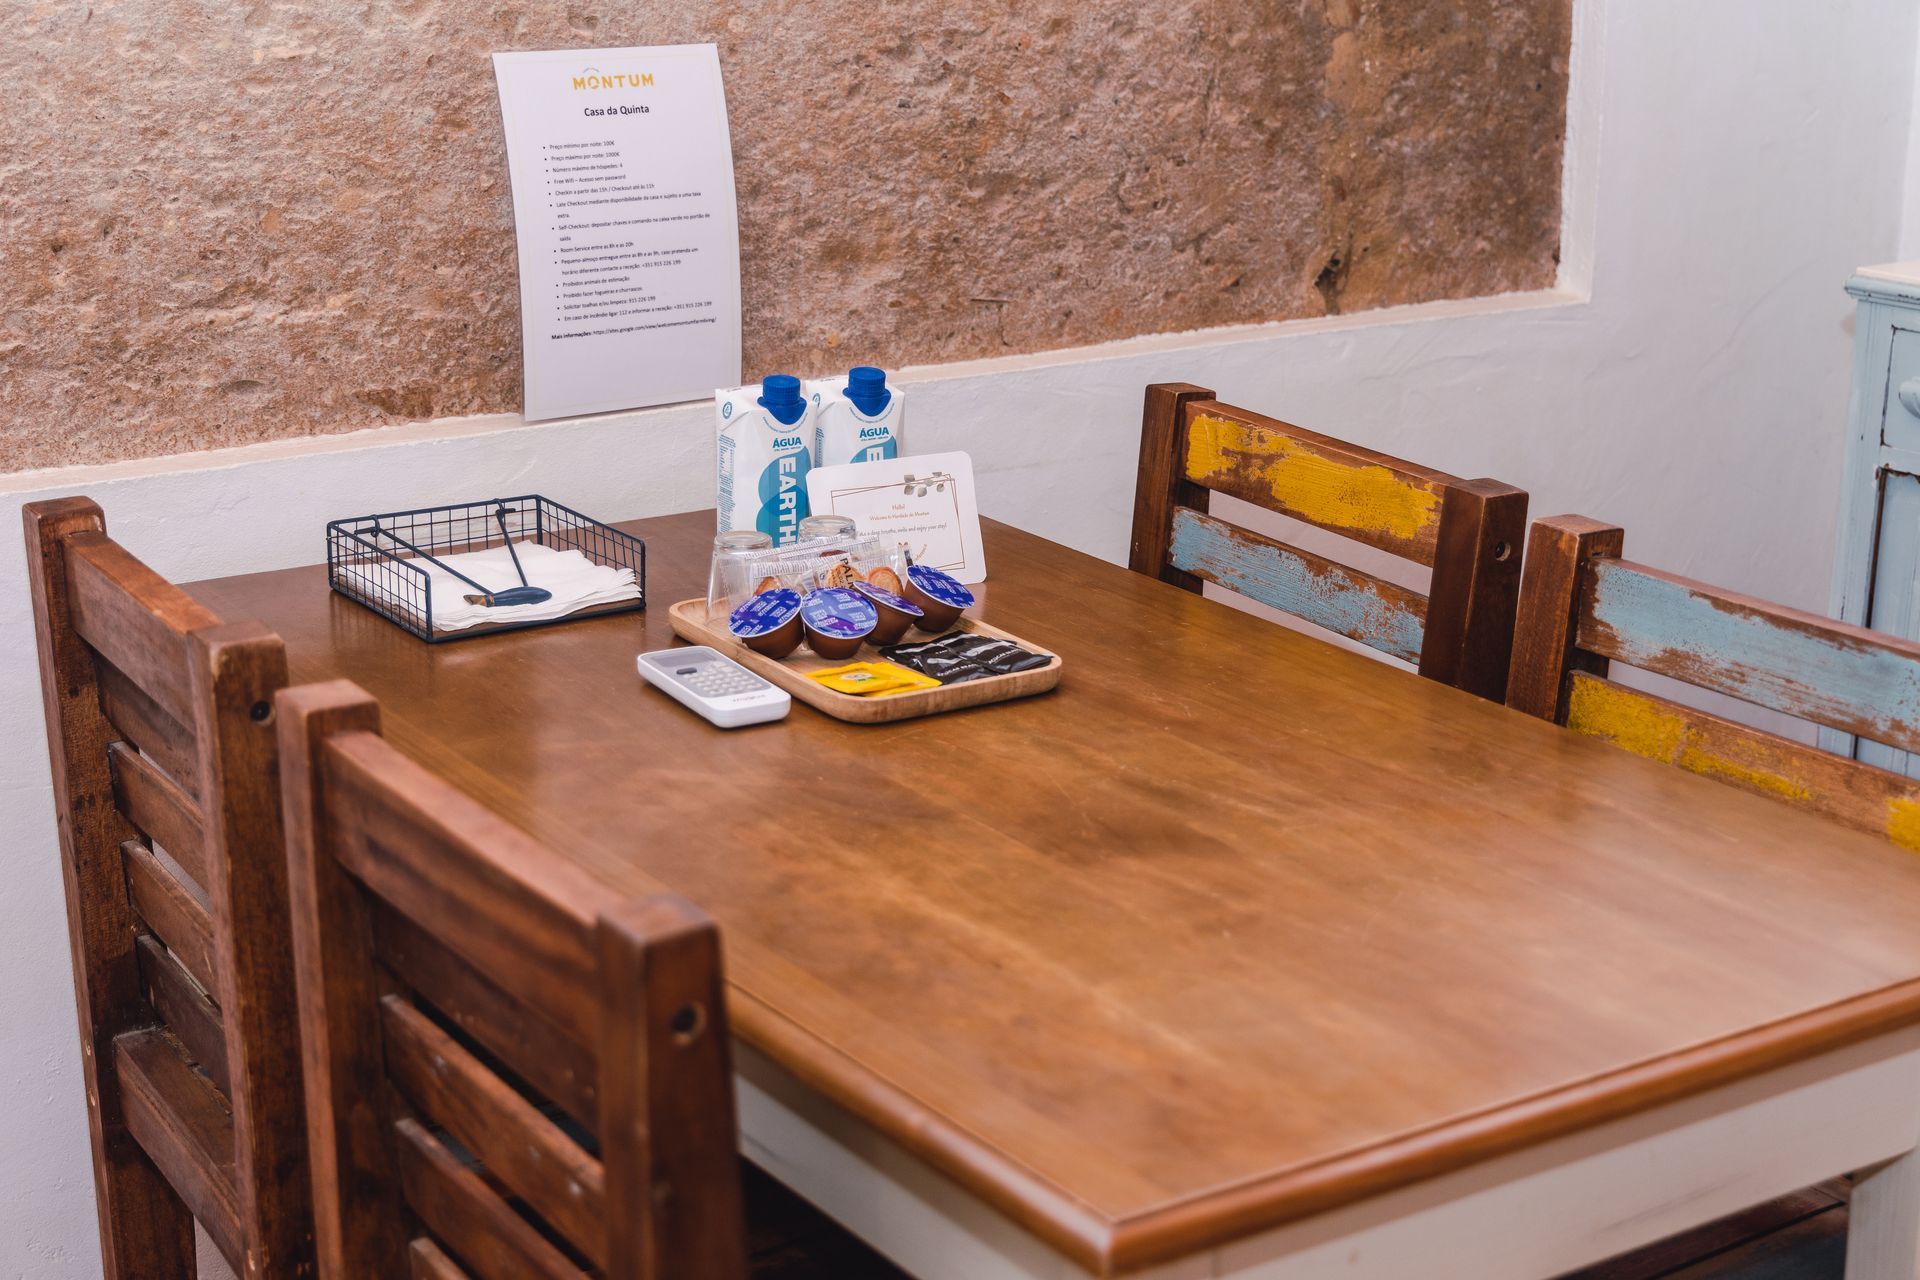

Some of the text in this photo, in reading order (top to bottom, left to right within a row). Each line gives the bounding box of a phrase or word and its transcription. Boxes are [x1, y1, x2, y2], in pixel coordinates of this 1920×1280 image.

[572, 73, 654, 90] MONTUM
[584, 104, 650, 117] Casa da Quinta
[859, 427, 890, 438] ÁGUA
[772, 437, 802, 448] ÁGUA
[779, 456, 797, 543] EARTH
